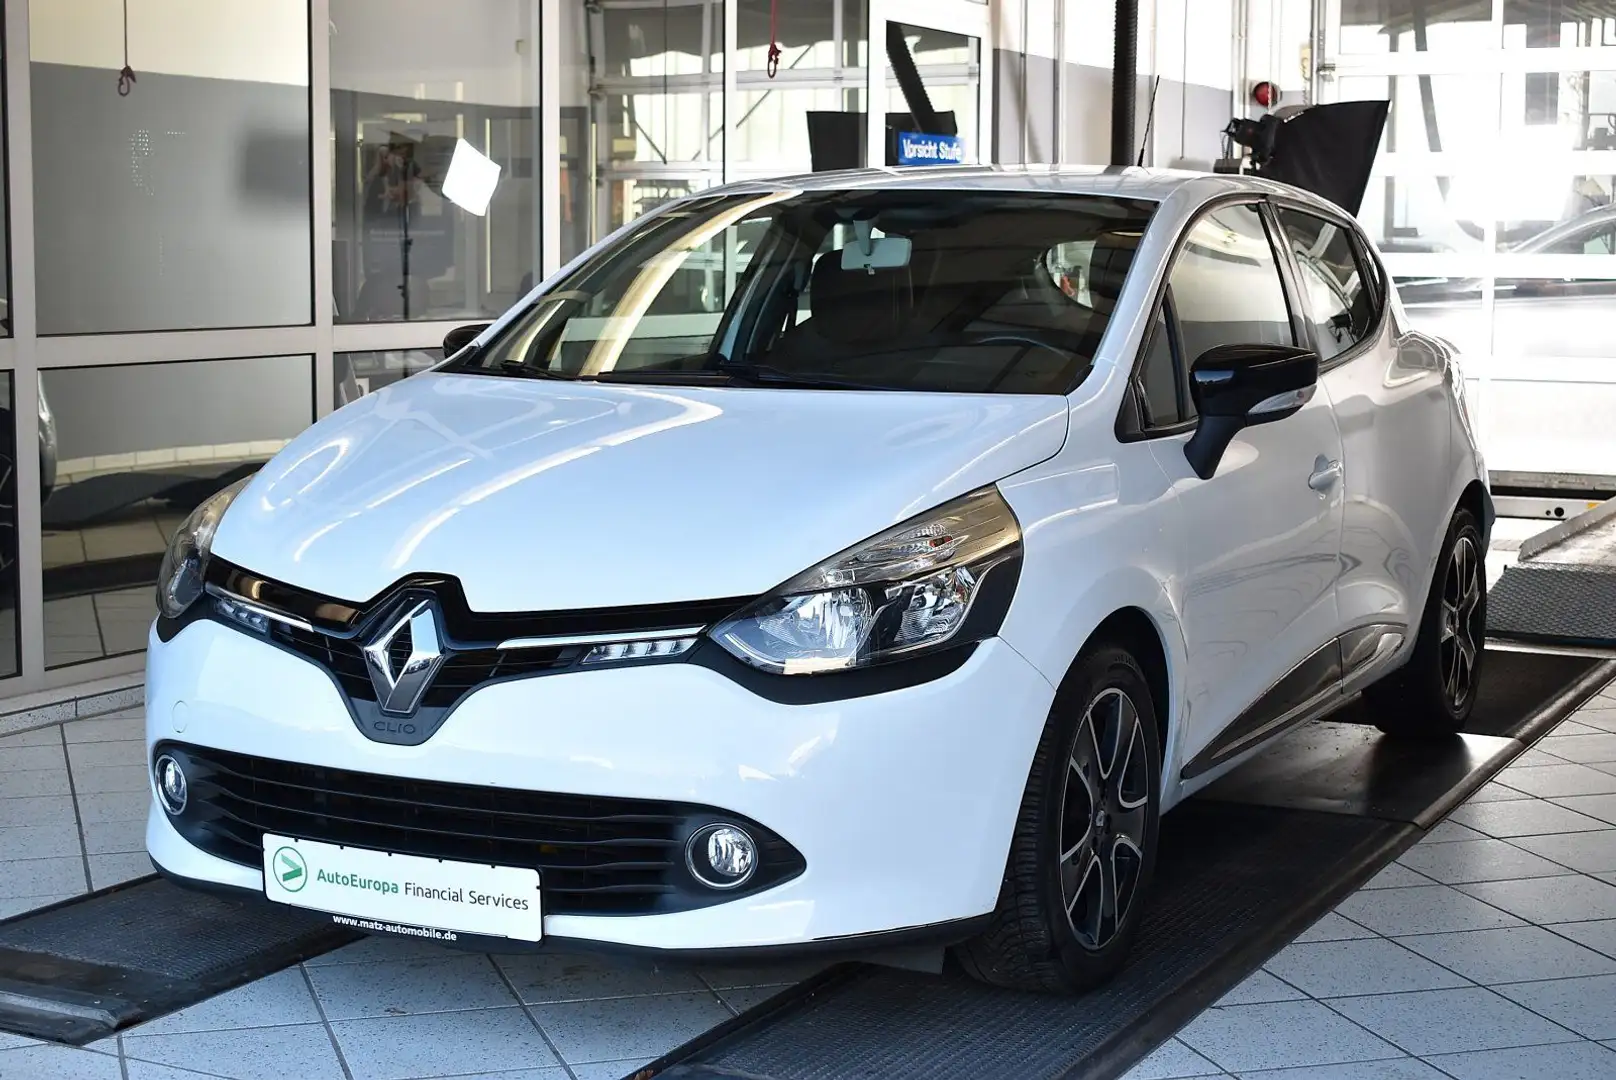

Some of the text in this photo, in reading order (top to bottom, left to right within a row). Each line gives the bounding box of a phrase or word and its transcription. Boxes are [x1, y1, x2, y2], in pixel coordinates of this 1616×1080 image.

[903, 138, 962, 161] Vorsicht Stufe
[374, 721, 416, 734] CLIO
[316, 868, 529, 911] AutoEuropa Financial Services
[333, 915, 457, 941] www.matz-automobile.de
